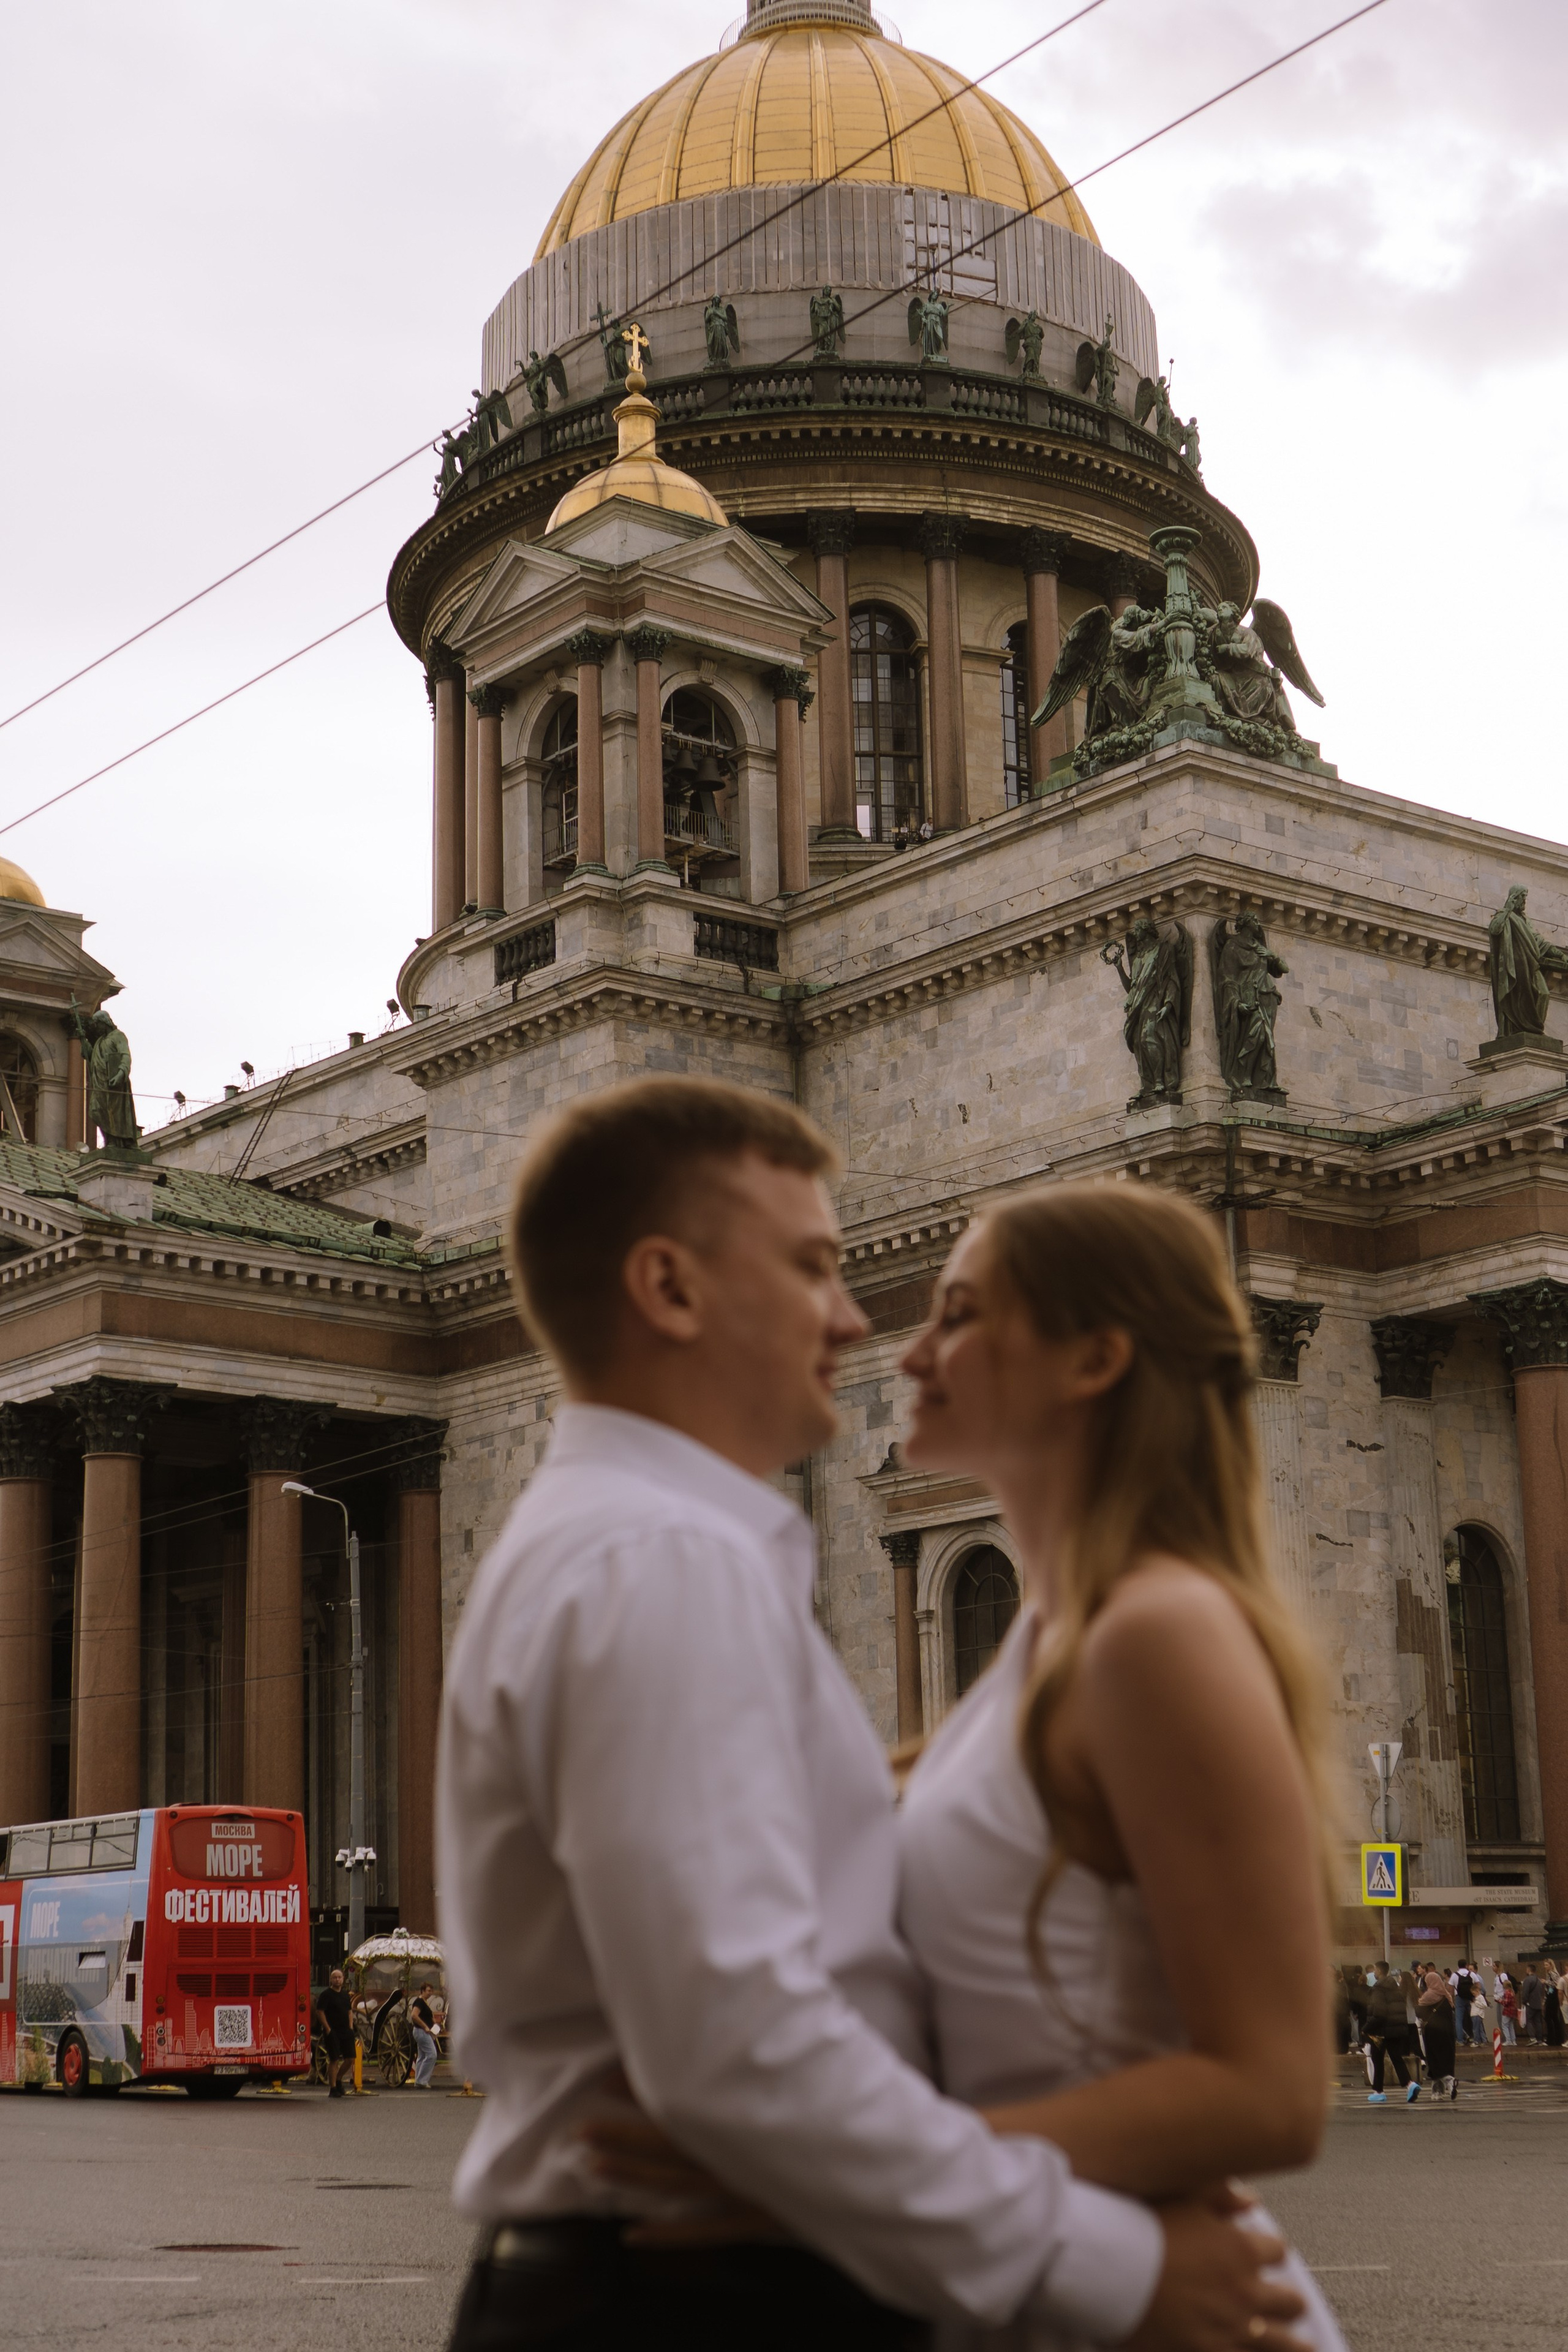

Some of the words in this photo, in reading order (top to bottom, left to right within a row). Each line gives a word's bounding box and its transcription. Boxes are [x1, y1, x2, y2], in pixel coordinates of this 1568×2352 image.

[215, 1825, 252, 1836] МОСКВА
[206, 1844, 263, 1877] МОРЕ
[30, 1901, 61, 1939] МОРЕ
[165, 1884, 300, 1923] ФЕСТИВАЛЕЙ
